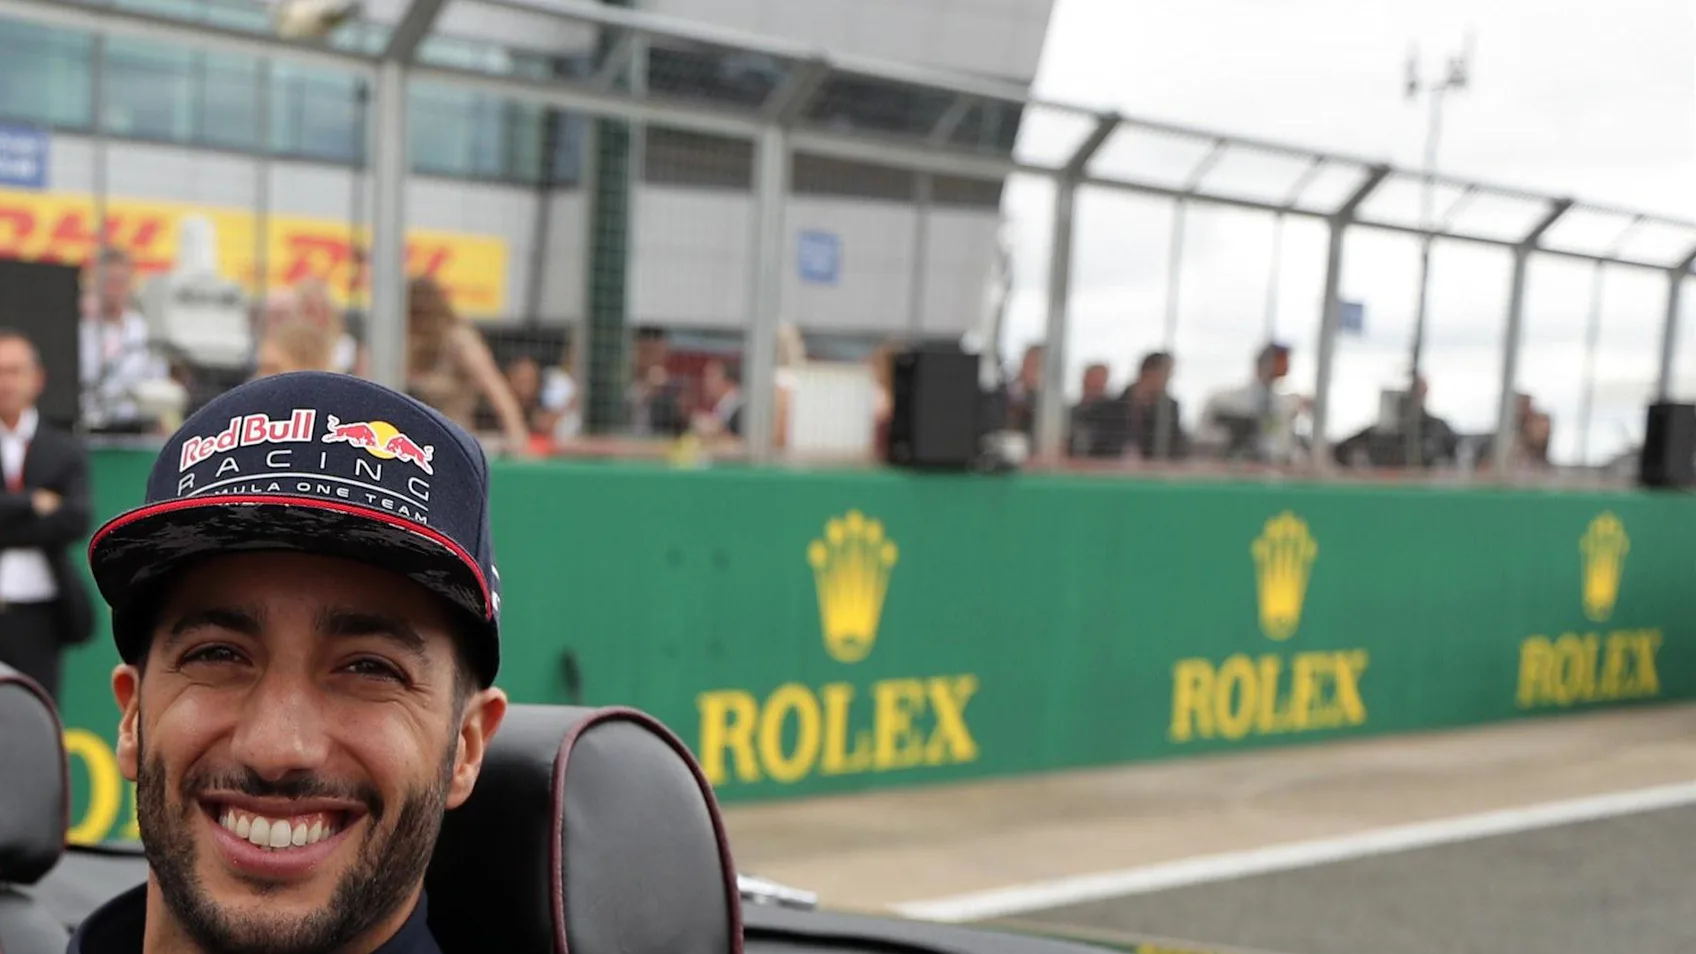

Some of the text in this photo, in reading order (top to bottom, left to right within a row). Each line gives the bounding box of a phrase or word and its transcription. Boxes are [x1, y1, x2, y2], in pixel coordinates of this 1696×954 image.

[177, 449, 430, 502] RACING
[296, 482, 350, 498] ONE
[365, 493, 428, 525] TEAM
[1170, 649, 1368, 742] ROLEX
[1518, 627, 1661, 708] ROLEX
[696, 673, 978, 786] ROLEX
